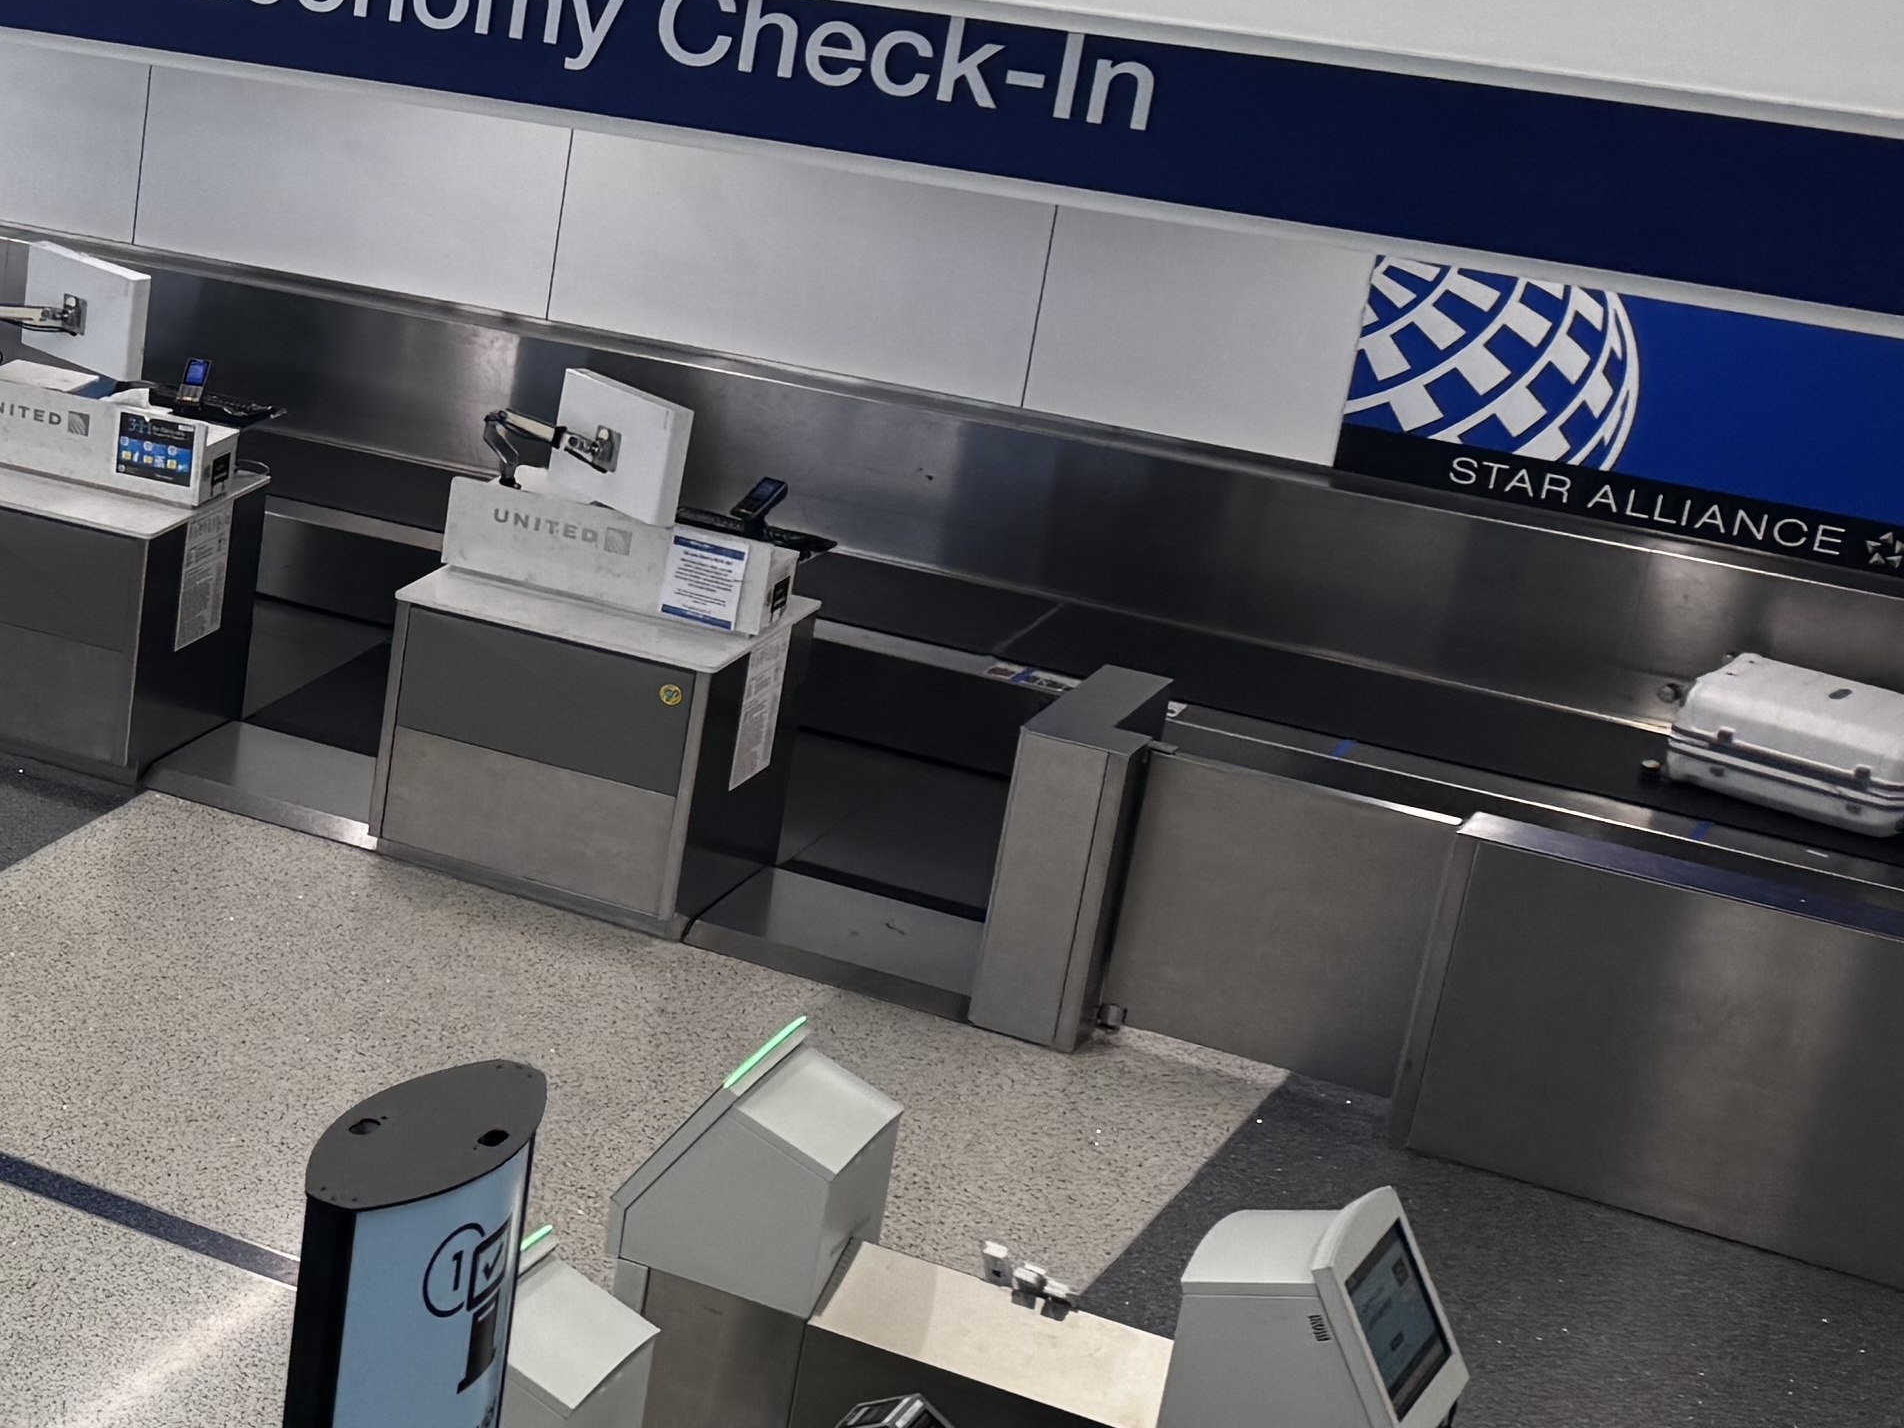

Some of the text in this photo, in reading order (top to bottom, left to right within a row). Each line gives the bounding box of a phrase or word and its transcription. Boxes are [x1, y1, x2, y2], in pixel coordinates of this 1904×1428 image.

[492, 506, 600, 545] UNITED
[1448, 457, 1848, 557] STAR ALLIANCE
